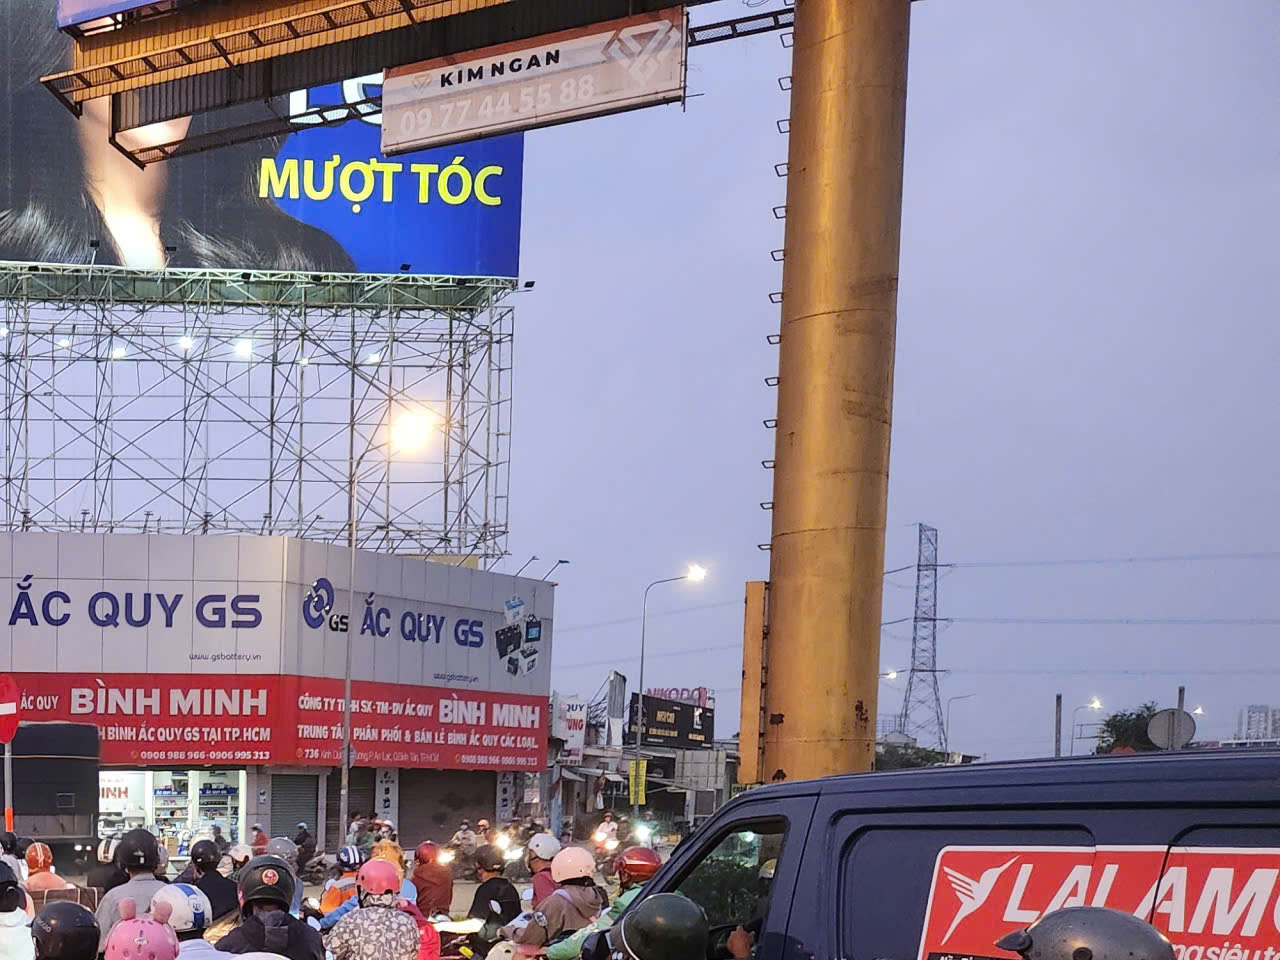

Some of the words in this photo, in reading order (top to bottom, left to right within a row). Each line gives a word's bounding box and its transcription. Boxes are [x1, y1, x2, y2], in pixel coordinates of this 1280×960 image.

[400, 107, 432, 137] 09
[439, 100, 470, 127] 77
[478, 92, 511, 117] 44
[519, 83, 552, 113] 55
[560, 74, 595, 101] 88
[259, 153, 402, 214] MƯỢT
[411, 156, 503, 206] TÓC
[8, 575, 70, 627] ẮC
[88, 592, 183, 629] QUY
[195, 594, 262, 629] GS
[360, 592, 391, 637] ẮC
[400, 611, 446, 643] QUY
[454, 619, 484, 648] GS
[37, 695, 59, 709] QUY
[70, 678, 160, 715] BÌNH
[169, 688, 268, 716] MINH
[439, 693, 486, 725] BÌNH
[492, 703, 540, 728] MINH
[107, 723, 136, 741] BÌNH
[157, 727, 182, 741] QUY
[184, 727, 200, 741] GS
[202, 727, 220, 745] TẠI
[224, 727, 270, 741] TP.HCM
[297, 725, 328, 739] TRUNG
[354, 724, 378, 740] PHÂN
[140, 751, 166, 760] 0908
[234, 752, 252, 760] 995
[253, 752, 270, 760] 313
